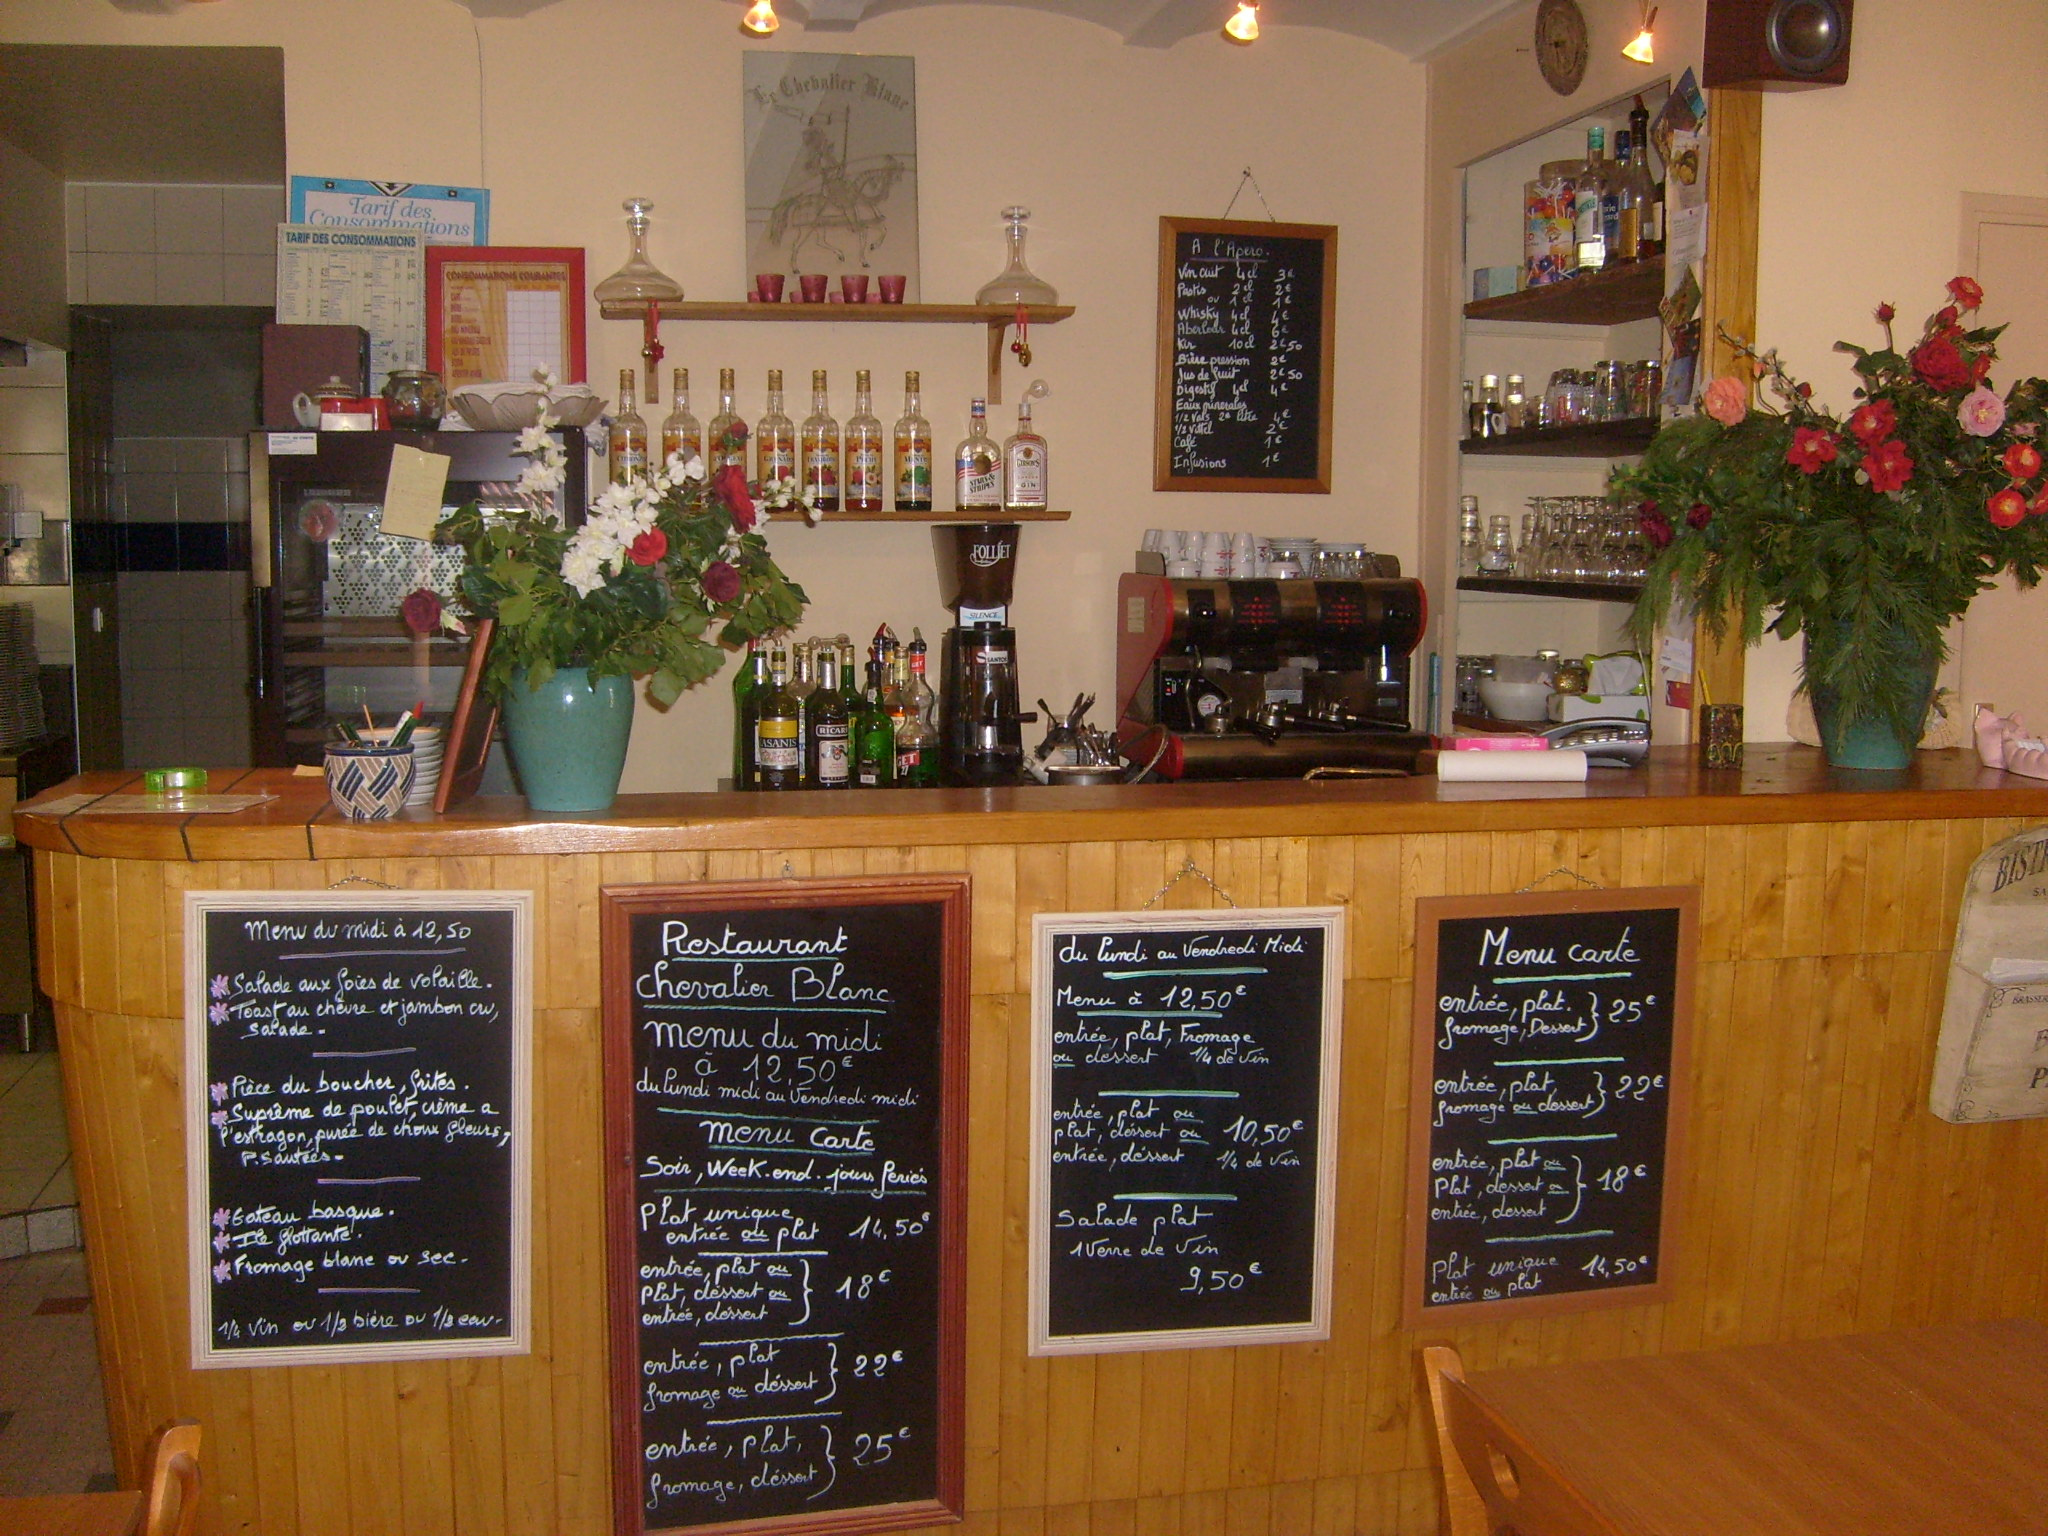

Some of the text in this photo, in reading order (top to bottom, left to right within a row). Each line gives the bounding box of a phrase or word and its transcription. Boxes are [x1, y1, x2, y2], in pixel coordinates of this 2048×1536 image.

[349, 196, 432, 220] Tarif des
[286, 232, 417, 248] TARIF DES CONSOMMATIONS
[1178, 283, 1207, 298] Pastis
[1178, 306, 1220, 324] Whisky
[1177, 337, 1197, 350] Kir
[1198, 368, 1210, 380] de
[245, 920, 307, 941] Menu
[314, 919, 338, 940] du
[342, 918, 389, 940] midi
[662, 920, 849, 956] Restaurant
[1059, 935, 1089, 964] du
[1097, 936, 1149, 963] lundi
[1157, 949, 1178, 960] au
[1479, 926, 1557, 966] Menu
[229, 968, 402, 1001] Salade aux foies de
[636, 960, 775, 1000] Chevalier
[1057, 988, 1143, 1007] Menu à
[230, 999, 463, 1026] Toast au jambon
[761, 1017, 883, 1052] du midi
[1179, 1022, 1256, 1054] Fromage
[695, 1052, 719, 1077] à
[1053, 1054, 1074, 1063] ou
[1216, 1051, 1234, 1065] de
[281, 1072, 310, 1093] du
[636, 1066, 920, 1107] du lundi midi au midi
[322, 1100, 346, 1117] de
[1117, 1098, 1195, 1127] plat ou
[1432, 1099, 1538, 1127] fromage ou
[367, 1121, 388, 1137] de
[1179, 1129, 1202, 1139] ou
[1246, 1151, 1263, 1168] de
[1499, 1148, 1562, 1178] plat ou
[703, 1206, 794, 1228] unique
[1055, 1202, 1214, 1237] Salade plat
[666, 1217, 820, 1252] entrée ou plat
[1141, 1236, 1164, 1256] de
[232, 1253, 314, 1283] Fromage
[388, 1254, 409, 1266] ou
[715, 1257, 793, 1285] plat ou
[1488, 1255, 1560, 1278] unique
[768, 1288, 791, 1300] ou
[1431, 1273, 1542, 1302] entrée ou plat
[292, 1319, 317, 1331] ou
[405, 1312, 426, 1325] ou
[729, 1343, 781, 1379] plat
[643, 1382, 749, 1412] fromage ou
